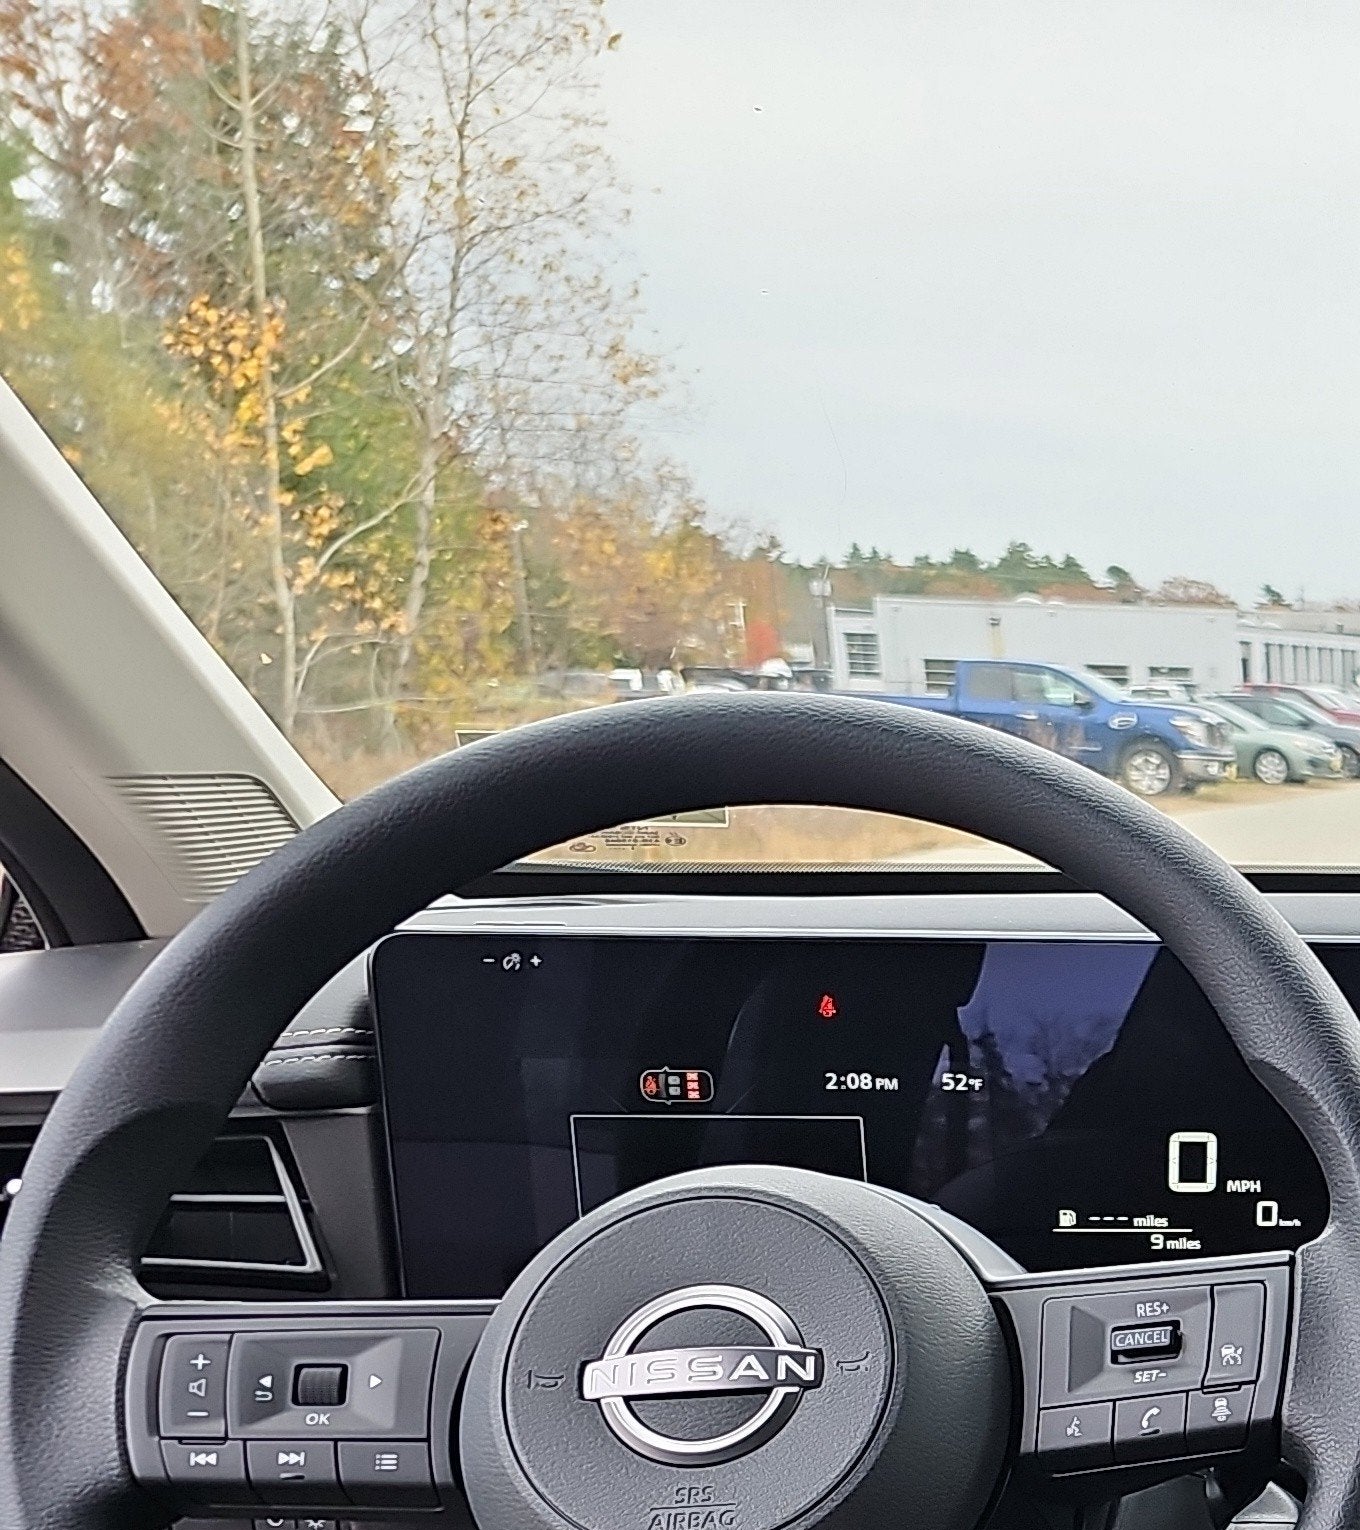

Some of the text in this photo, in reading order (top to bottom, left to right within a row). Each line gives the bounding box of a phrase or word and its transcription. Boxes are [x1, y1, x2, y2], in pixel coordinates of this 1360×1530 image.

[825, 1073, 899, 1091] 2:08 PM
[1169, 1132, 1217, 1193] 0
[1226, 1180, 1261, 1193] MPH
[1133, 1215, 1169, 1227] miles
[1256, 1201, 1278, 1227] 0
[1150, 1234, 1201, 1250] 9 miles
[1136, 1302, 1170, 1318] RES+
[1116, 1330, 1169, 1347] CANCEL
[589, 1354, 815, 1393] NISSAN
[305, 1413, 331, 1425] OK
[674, 1485, 715, 1504] SRS
[647, 1509, 736, 1530] AIRBAG
